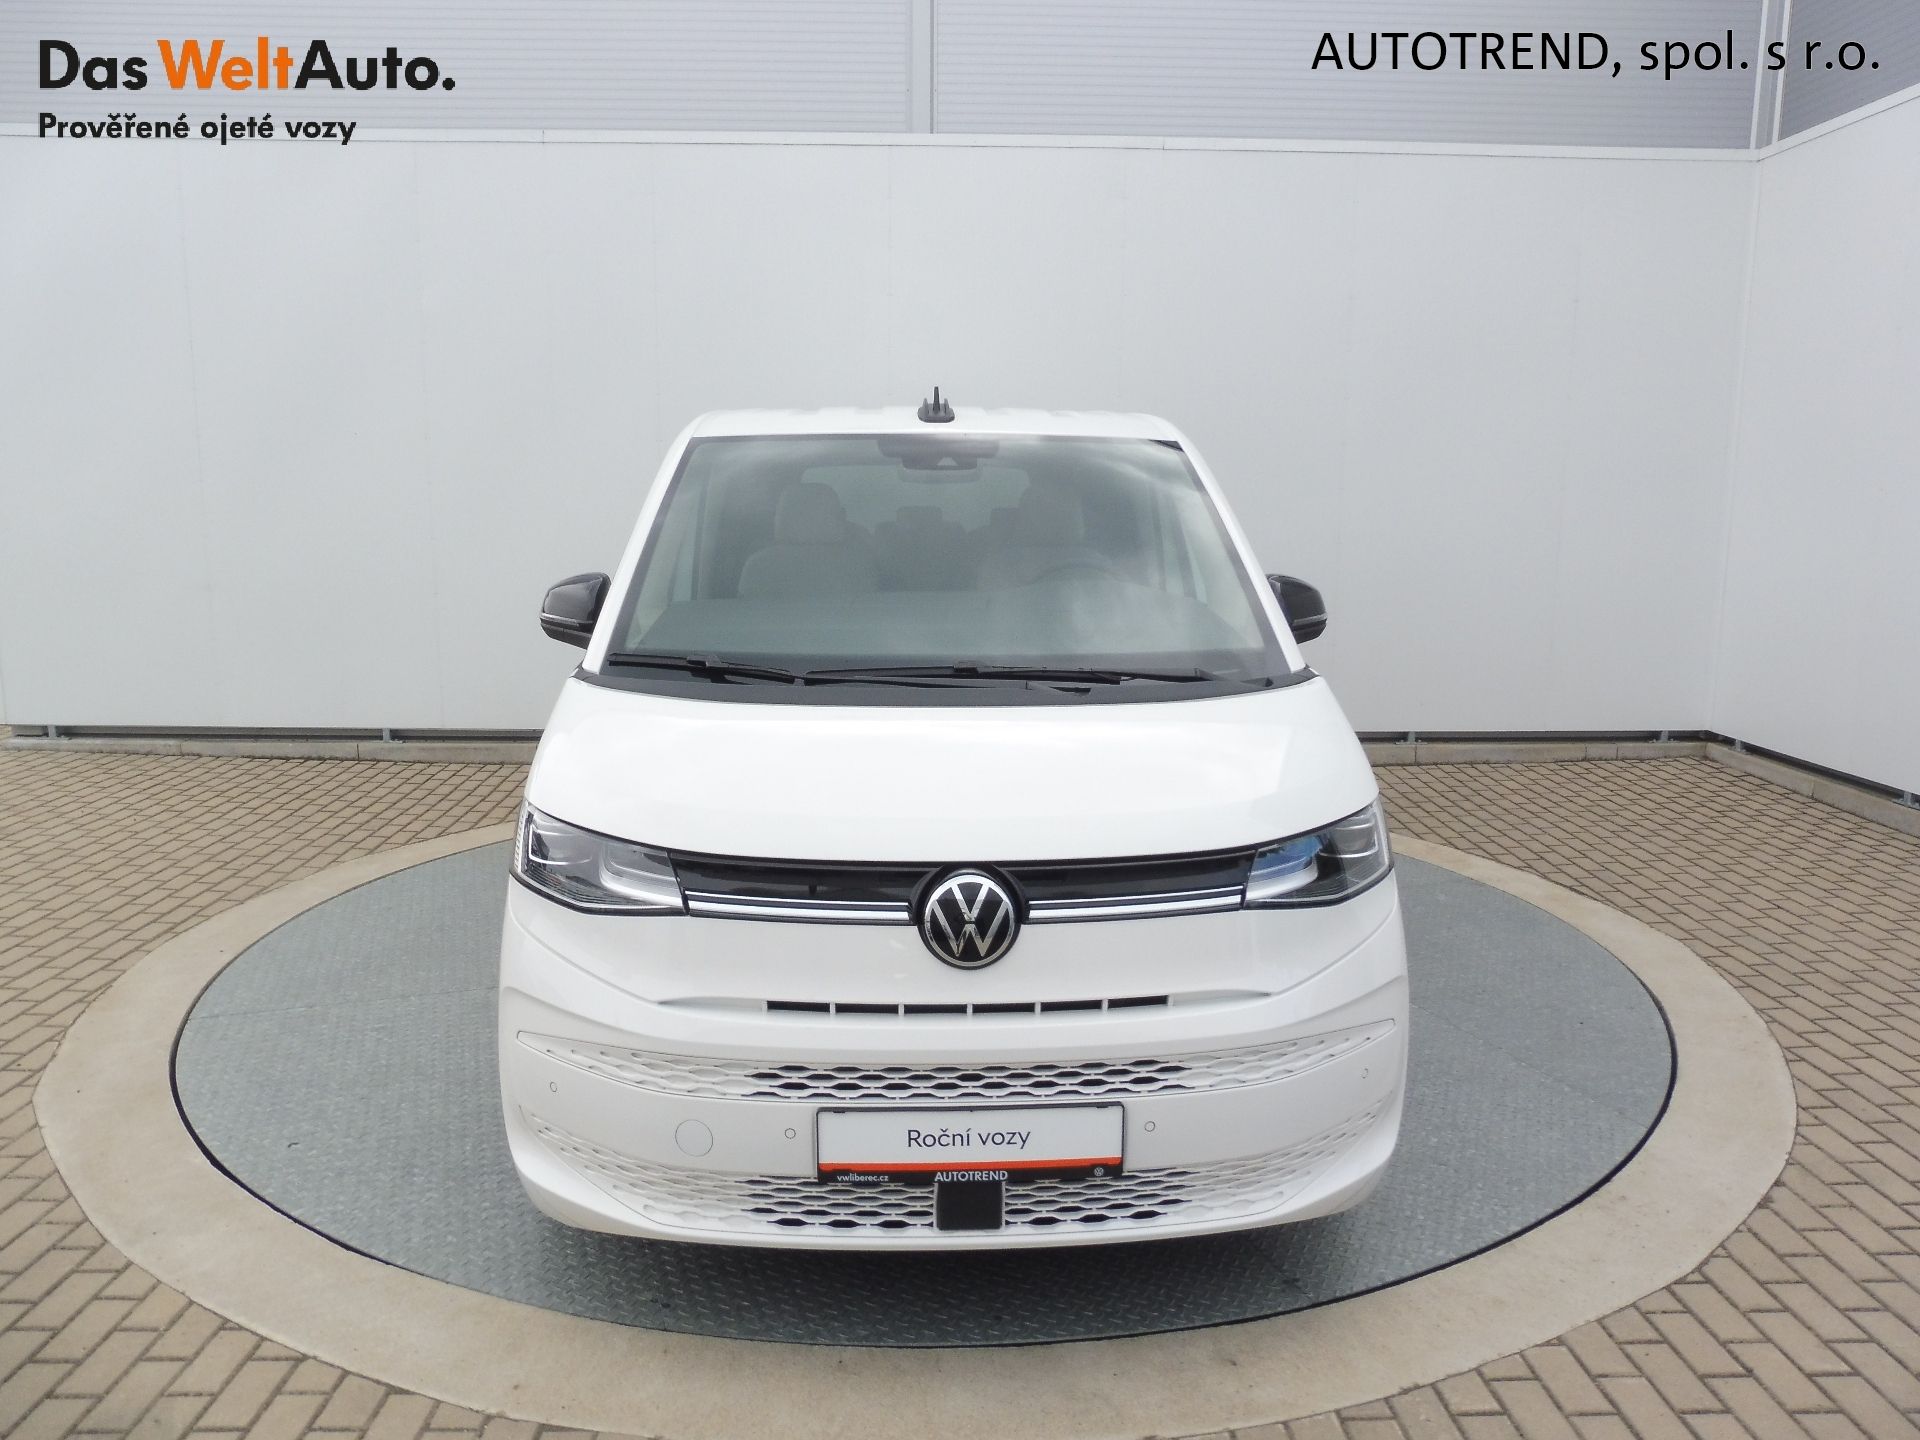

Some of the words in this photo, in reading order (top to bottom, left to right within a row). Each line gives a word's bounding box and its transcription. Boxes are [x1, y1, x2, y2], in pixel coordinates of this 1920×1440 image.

[907, 1127, 971, 1148] Roční
[977, 1130, 1031, 1150] vozy
[836, 1172, 889, 1183] vwliberec.cz
[934, 1170, 1009, 1182] AUTOTREND
